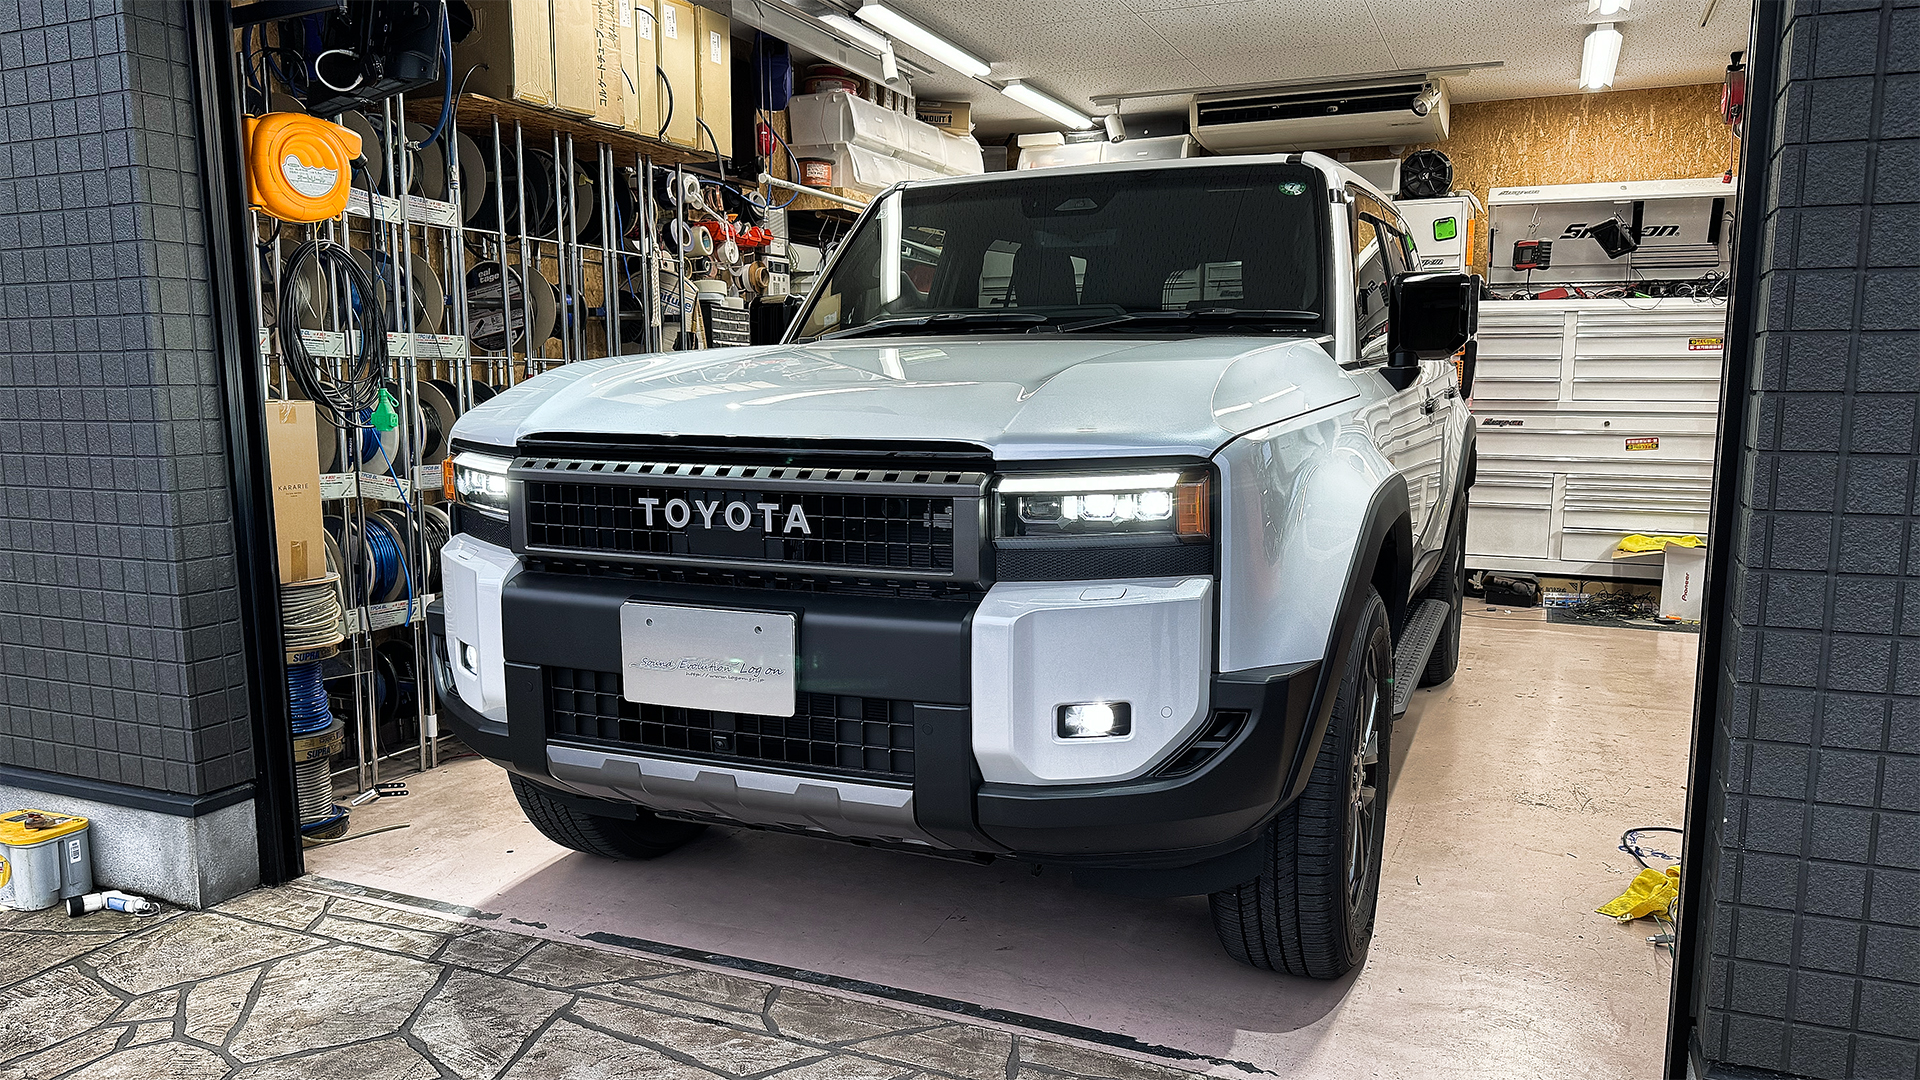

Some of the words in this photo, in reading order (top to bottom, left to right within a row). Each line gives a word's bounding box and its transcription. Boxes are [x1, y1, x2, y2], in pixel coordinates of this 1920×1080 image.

[638, 497, 812, 535] TOYOTA
[293, 650, 320, 662] SUPRA
[640, 657, 673, 669] Sound
[679, 660, 732, 673] Evolution
[307, 746, 330, 760] SUPRA
